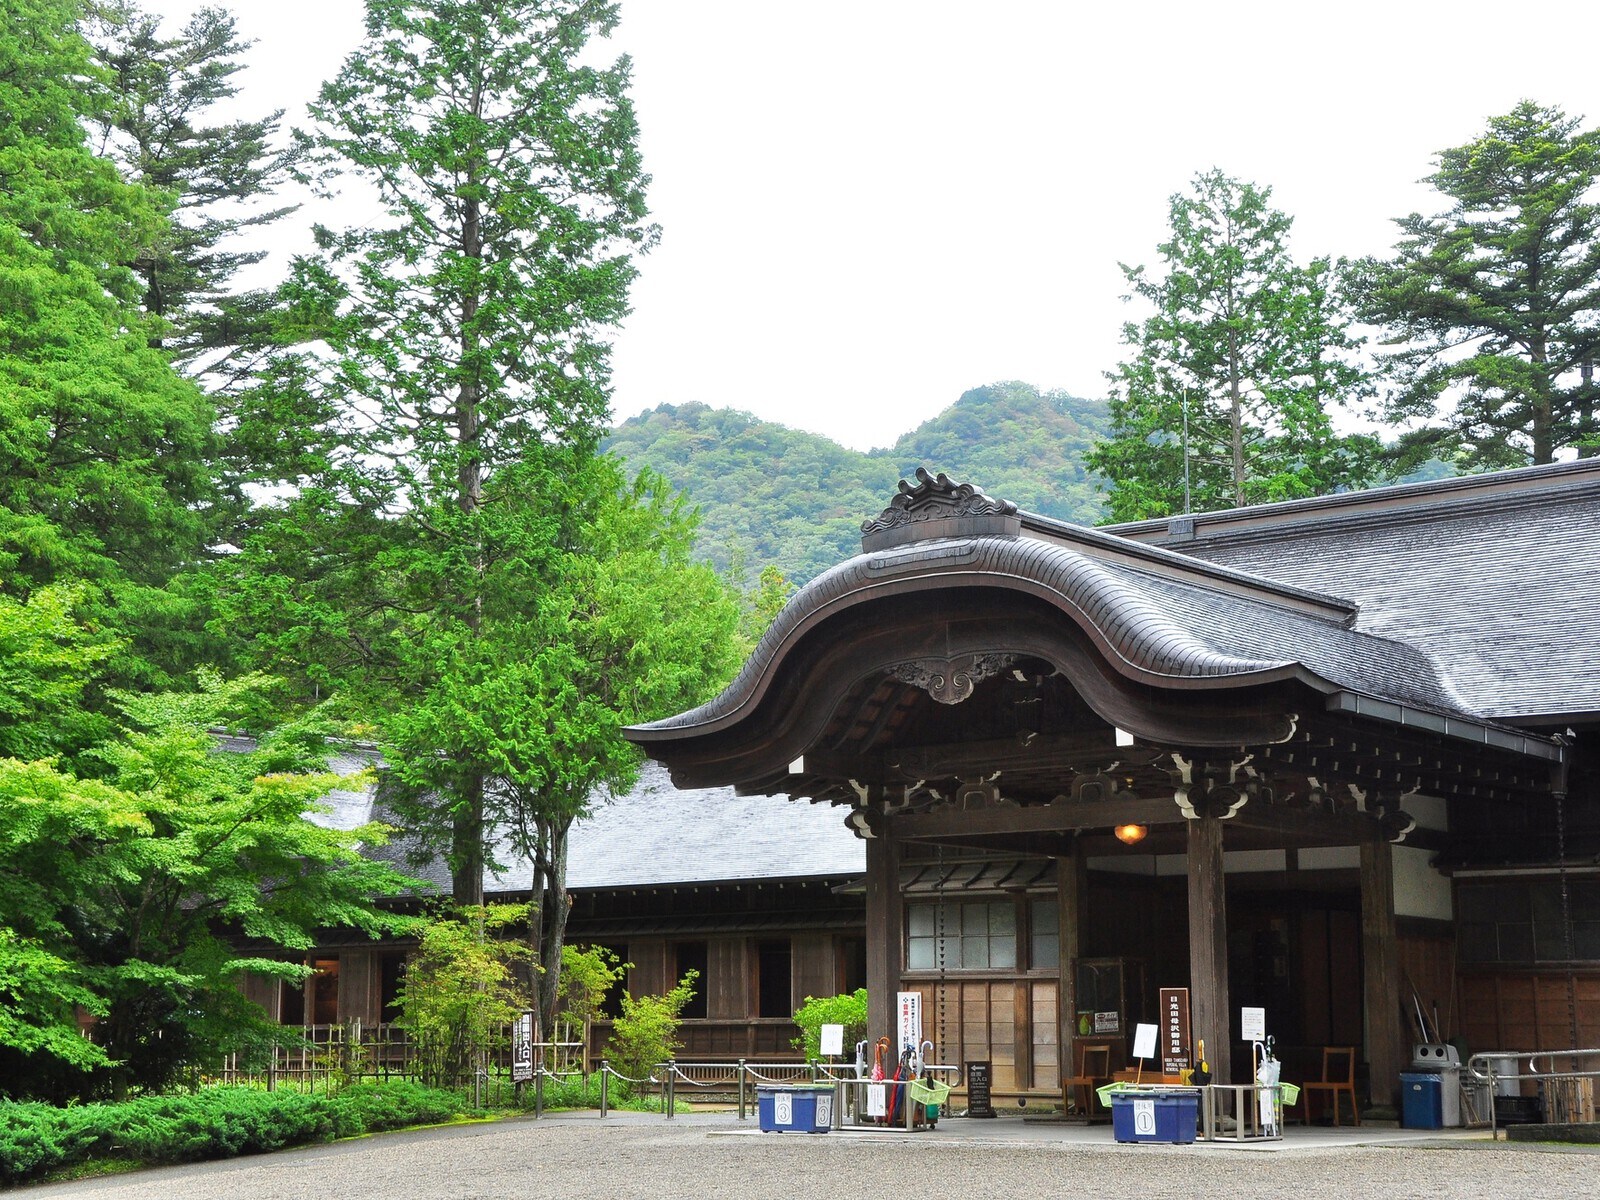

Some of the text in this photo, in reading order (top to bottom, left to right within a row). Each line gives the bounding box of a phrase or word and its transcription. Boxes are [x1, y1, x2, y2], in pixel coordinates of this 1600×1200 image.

[1170, 996, 1181, 1053] 日光田母沢御用邸
